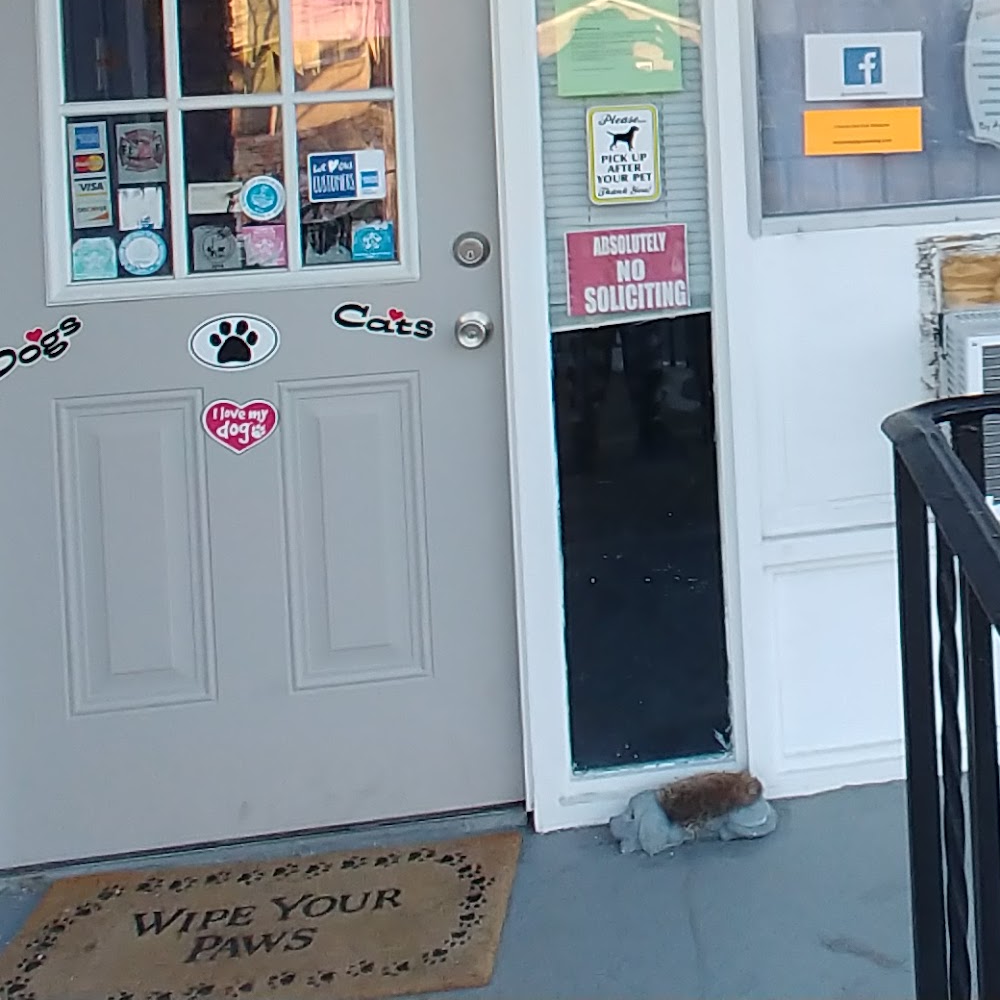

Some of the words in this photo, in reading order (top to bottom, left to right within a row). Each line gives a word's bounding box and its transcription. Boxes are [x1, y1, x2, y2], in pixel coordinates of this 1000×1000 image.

[601, 154, 628, 164] PICK
[632, 153, 647, 162] UP
[607, 163, 641, 173] AFTER
[78, 182, 105, 192] VISA
[597, 174, 629, 184] YOUR
[632, 172, 652, 182] PET
[593, 231, 667, 257] ABSOLUTELY
[616, 257, 646, 283] NO
[584, 279, 687, 315] SOLICITING
[334, 303, 434, 339] Cats
[212, 407, 218, 420] I
[219, 406, 246, 421] love
[248, 408, 269, 423] my
[132, 904, 257, 938] WIPE
[271, 886, 403, 921] YOUR
[183, 925, 318, 965] PAWS
